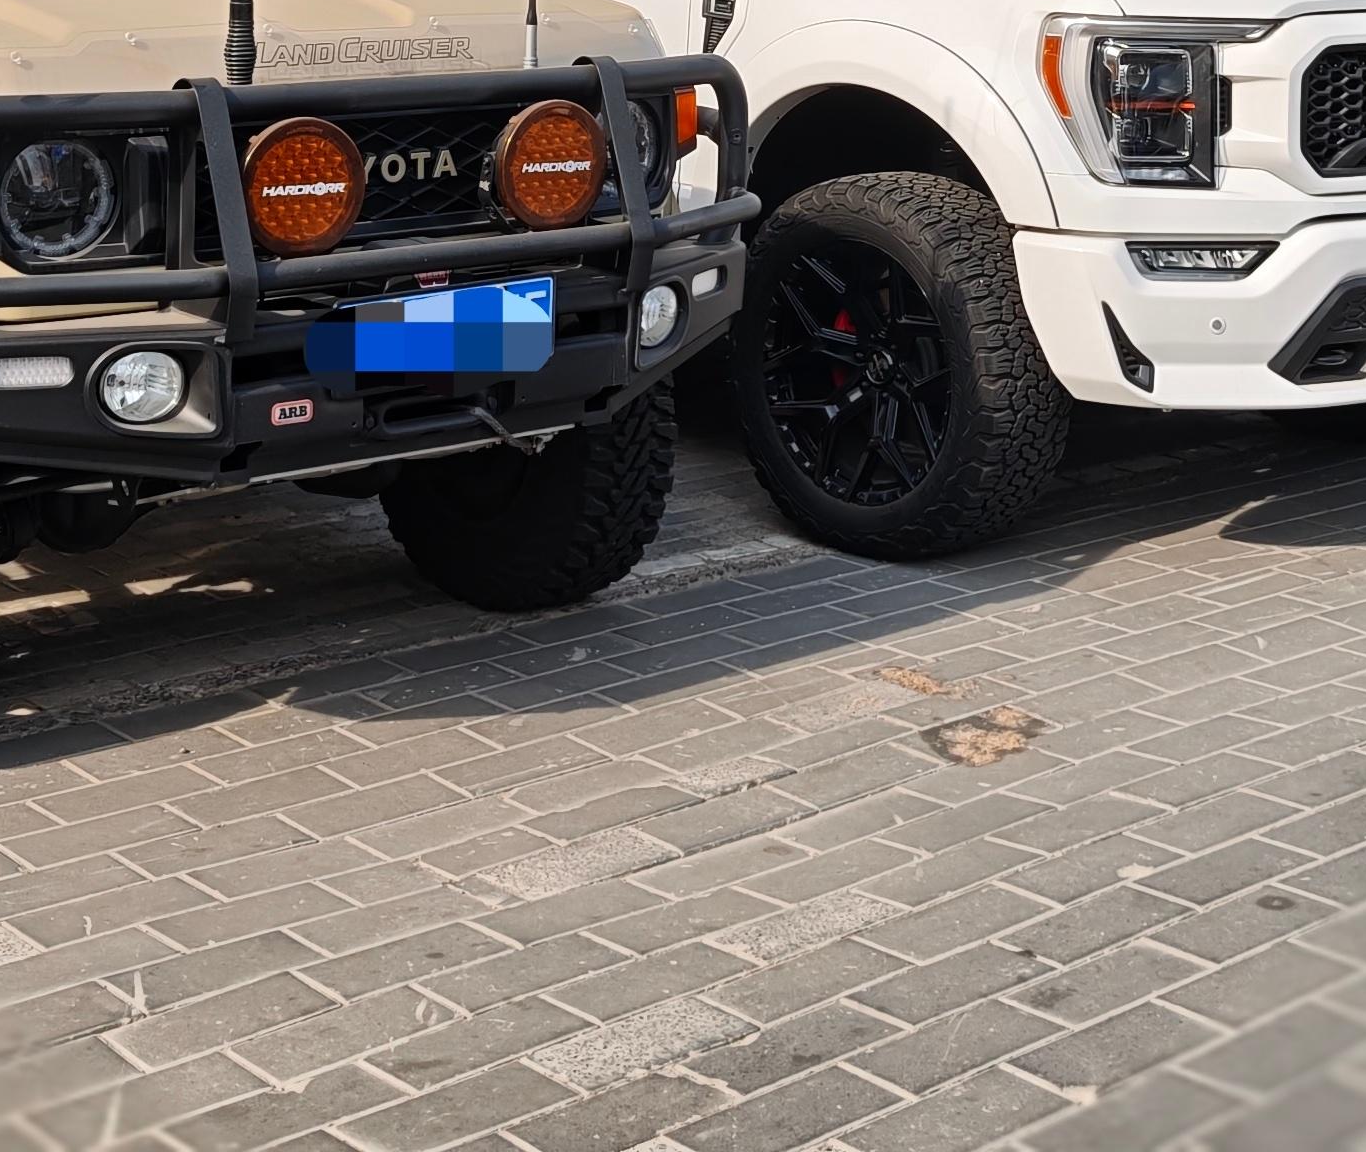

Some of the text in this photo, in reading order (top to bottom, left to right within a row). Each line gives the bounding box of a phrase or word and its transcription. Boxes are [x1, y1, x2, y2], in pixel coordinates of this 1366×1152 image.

[256, 37, 474, 68] LAND CRUISER
[522, 160, 591, 173] HARDKORR
[262, 181, 348, 197] HARDKORR
[278, 405, 307, 419] ARB
